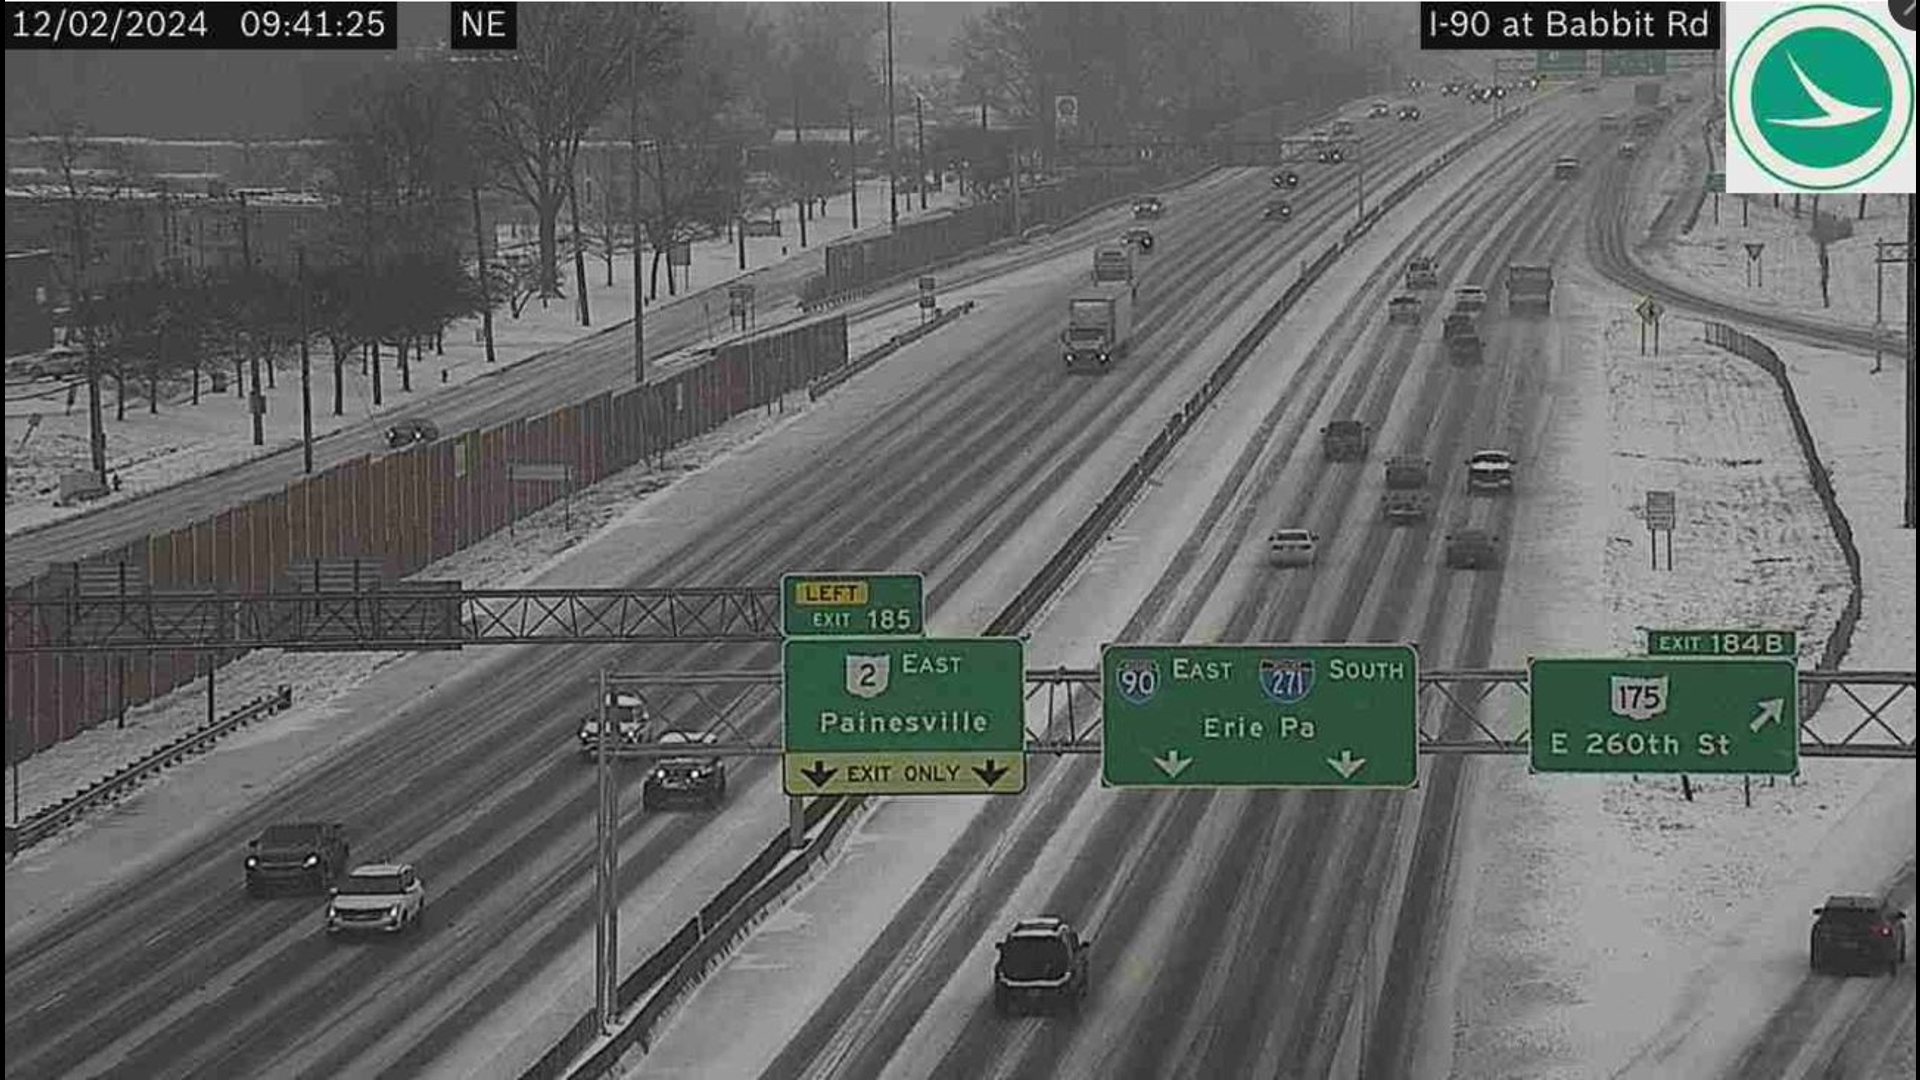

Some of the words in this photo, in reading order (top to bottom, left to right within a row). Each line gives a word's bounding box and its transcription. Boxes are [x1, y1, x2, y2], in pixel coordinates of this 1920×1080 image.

[805, 584, 859, 602] LEFT
[813, 612, 851, 627] EXIT
[868, 608, 911, 630] 185
[1660, 637, 1701, 651] EXIT
[1711, 633, 1784, 653] 184B
[903, 653, 961, 674] EAST
[1172, 658, 1233, 680] EAST
[1329, 659, 1405, 680] SOUTH
[859, 663, 877, 688] 2
[1122, 671, 1155, 694] 90
[1272, 670, 1303, 695] 271
[1619, 686, 1661, 710] 175
[820, 711, 988, 734] Painesville
[1204, 716, 1264, 738] Erie
[1281, 716, 1315, 738] Pa
[1551, 732, 1569, 755] E
[1586, 732, 1679, 755] 260th
[1698, 732, 1730, 755] St
[847, 765, 893, 783] EXIT
[904, 765, 961, 783] ONLY
